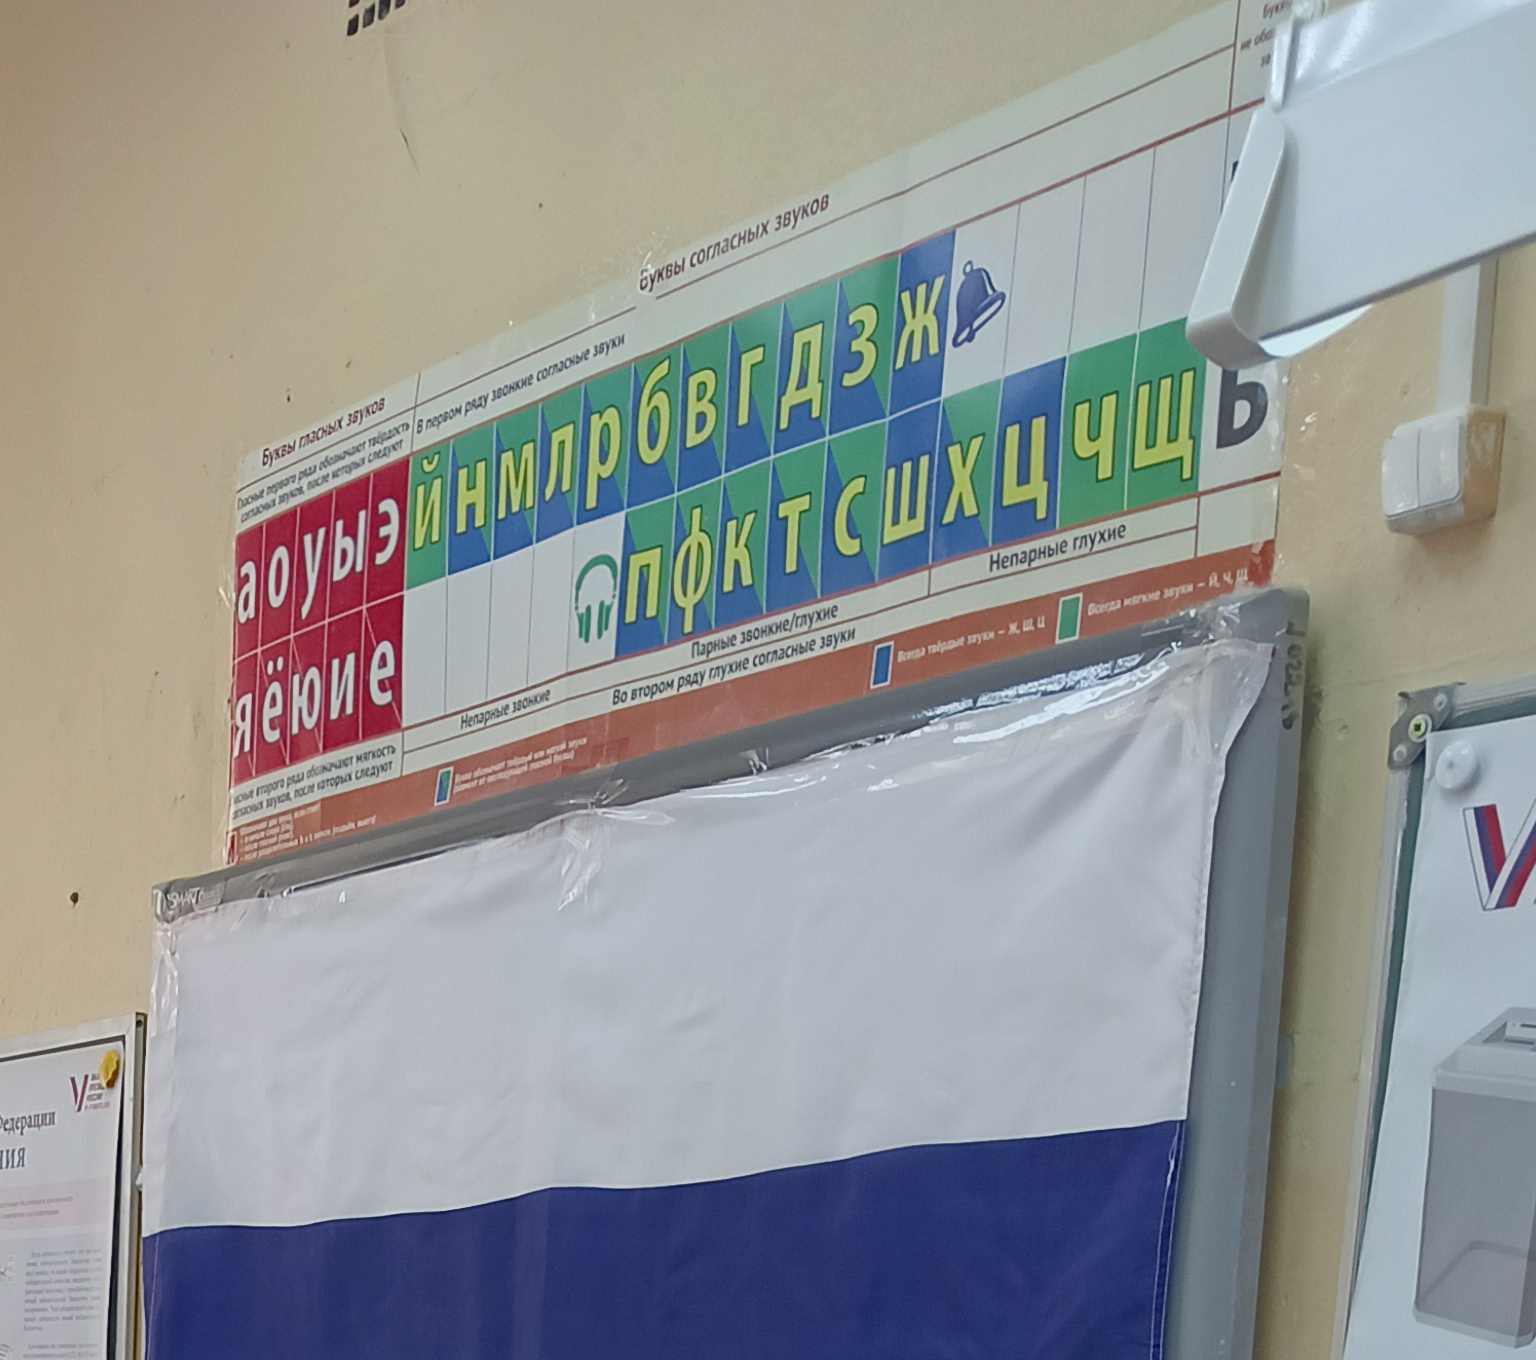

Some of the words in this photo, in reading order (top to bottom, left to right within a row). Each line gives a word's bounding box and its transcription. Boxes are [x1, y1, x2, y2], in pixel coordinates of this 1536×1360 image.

[639, 257, 685, 292] Буквы
[690, 220, 770, 267] согласных
[774, 194, 829, 231] звуков
[417, 422, 423, 434] В
[426, 405, 462, 430] первом
[464, 393, 489, 416] ряду
[492, 374, 533, 399] звонкие
[537, 350, 590, 382] согласные
[593, 333, 624, 358] звуки
[262, 440, 296, 467] Буквы
[299, 417, 343, 448] гласных
[347, 398, 385, 427] звуков
[368, 439, 404, 464] следуют
[988, 538, 1069, 573] Непарные
[1072, 523, 1127, 552] глухие
[1087, 598, 1122, 616] Всегда
[1163, 582, 1194, 599] звуки
[691, 633, 737, 659] Парные
[740, 604, 838, 645] звонкие/глухие
[612, 689, 628, 705] Во
[630, 677, 675, 699] втором
[677, 669, 707, 692] ряду
[708, 655, 750, 681] глухие
[752, 638, 817, 667] согласные
[819, 627, 856, 651] звуки
[460, 702, 510, 730] Непарные
[512, 689, 551, 714] звонкие
[317, 771, 353, 790] которых
[355, 760, 393, 780] следуют
[356, 744, 396, 764] мягкость
